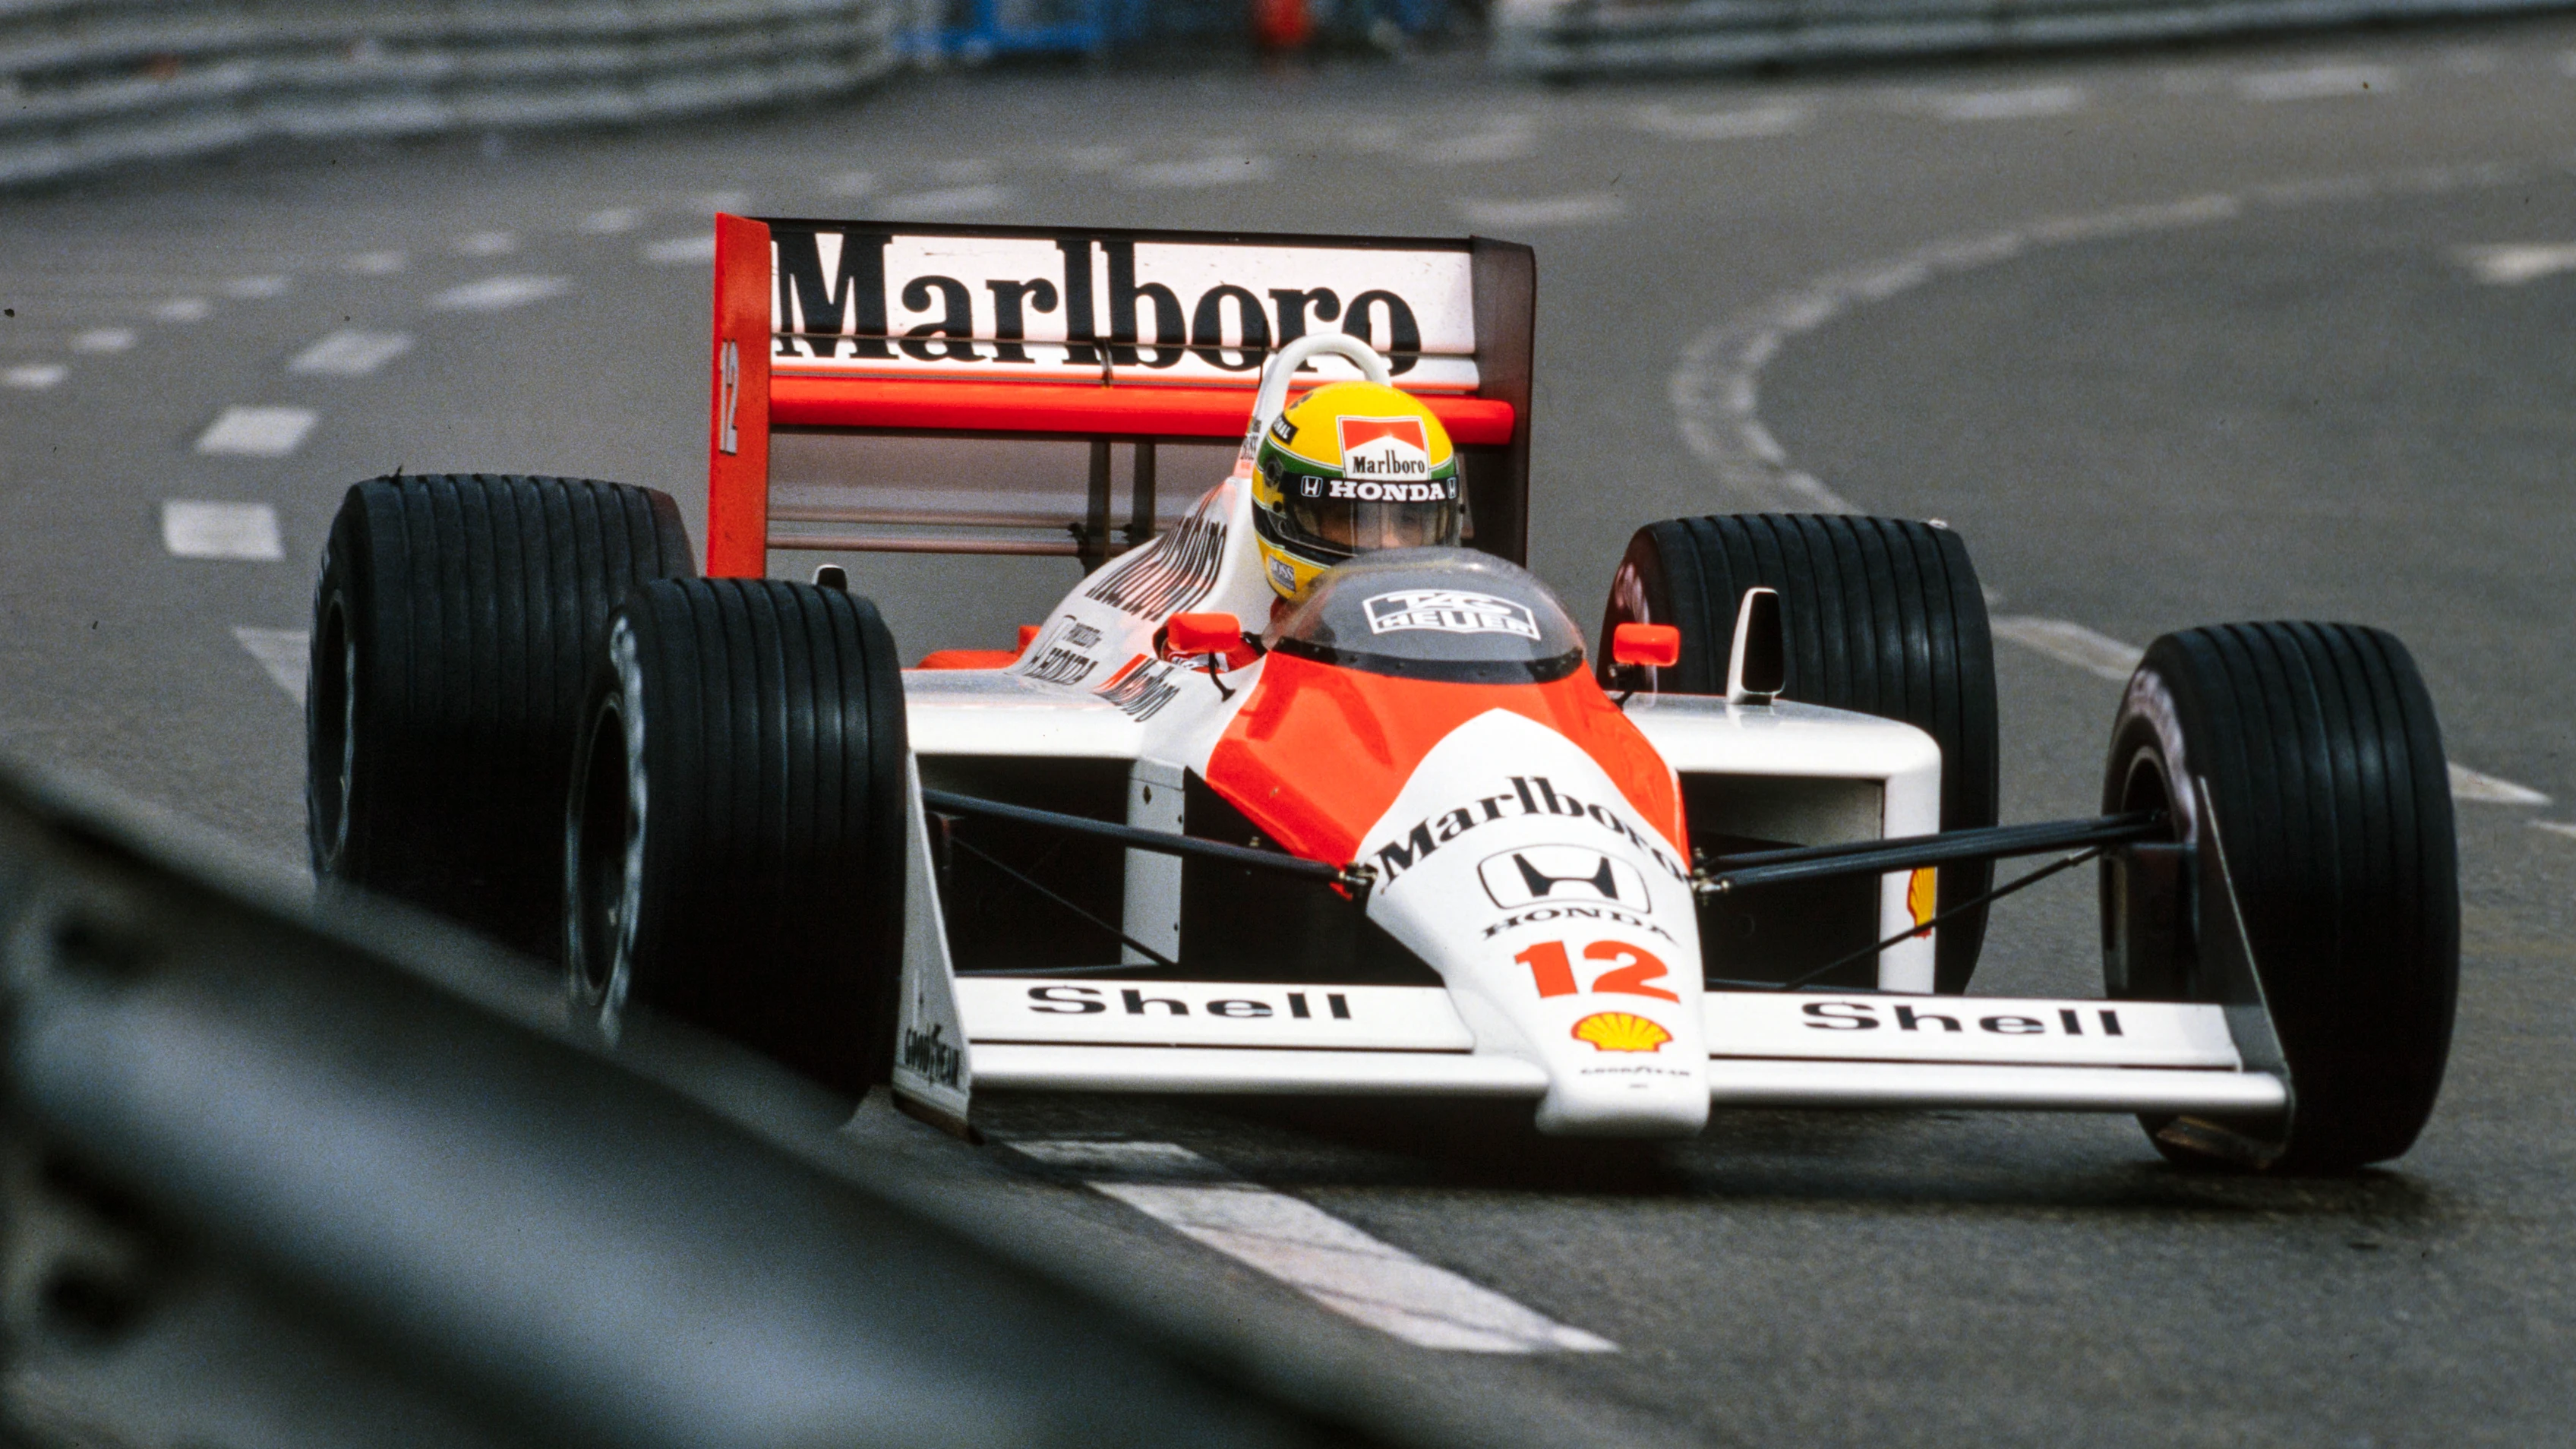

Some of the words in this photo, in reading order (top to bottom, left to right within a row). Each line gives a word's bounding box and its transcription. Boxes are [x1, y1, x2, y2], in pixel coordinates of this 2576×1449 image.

[770, 230, 1422, 376] Marlboro
[720, 339, 739, 456] 12
[1352, 450, 1426, 475] Marlboro
[1329, 480, 1446, 502] HONDA
[1384, 611, 1533, 635] HEUER
[1373, 775, 1689, 887] Marlboro
[1481, 908, 1680, 948] HONDA
[1514, 939, 1681, 1004] 12
[1028, 986, 1352, 1020] Shell
[1801, 1001, 2123, 1036] Shell
